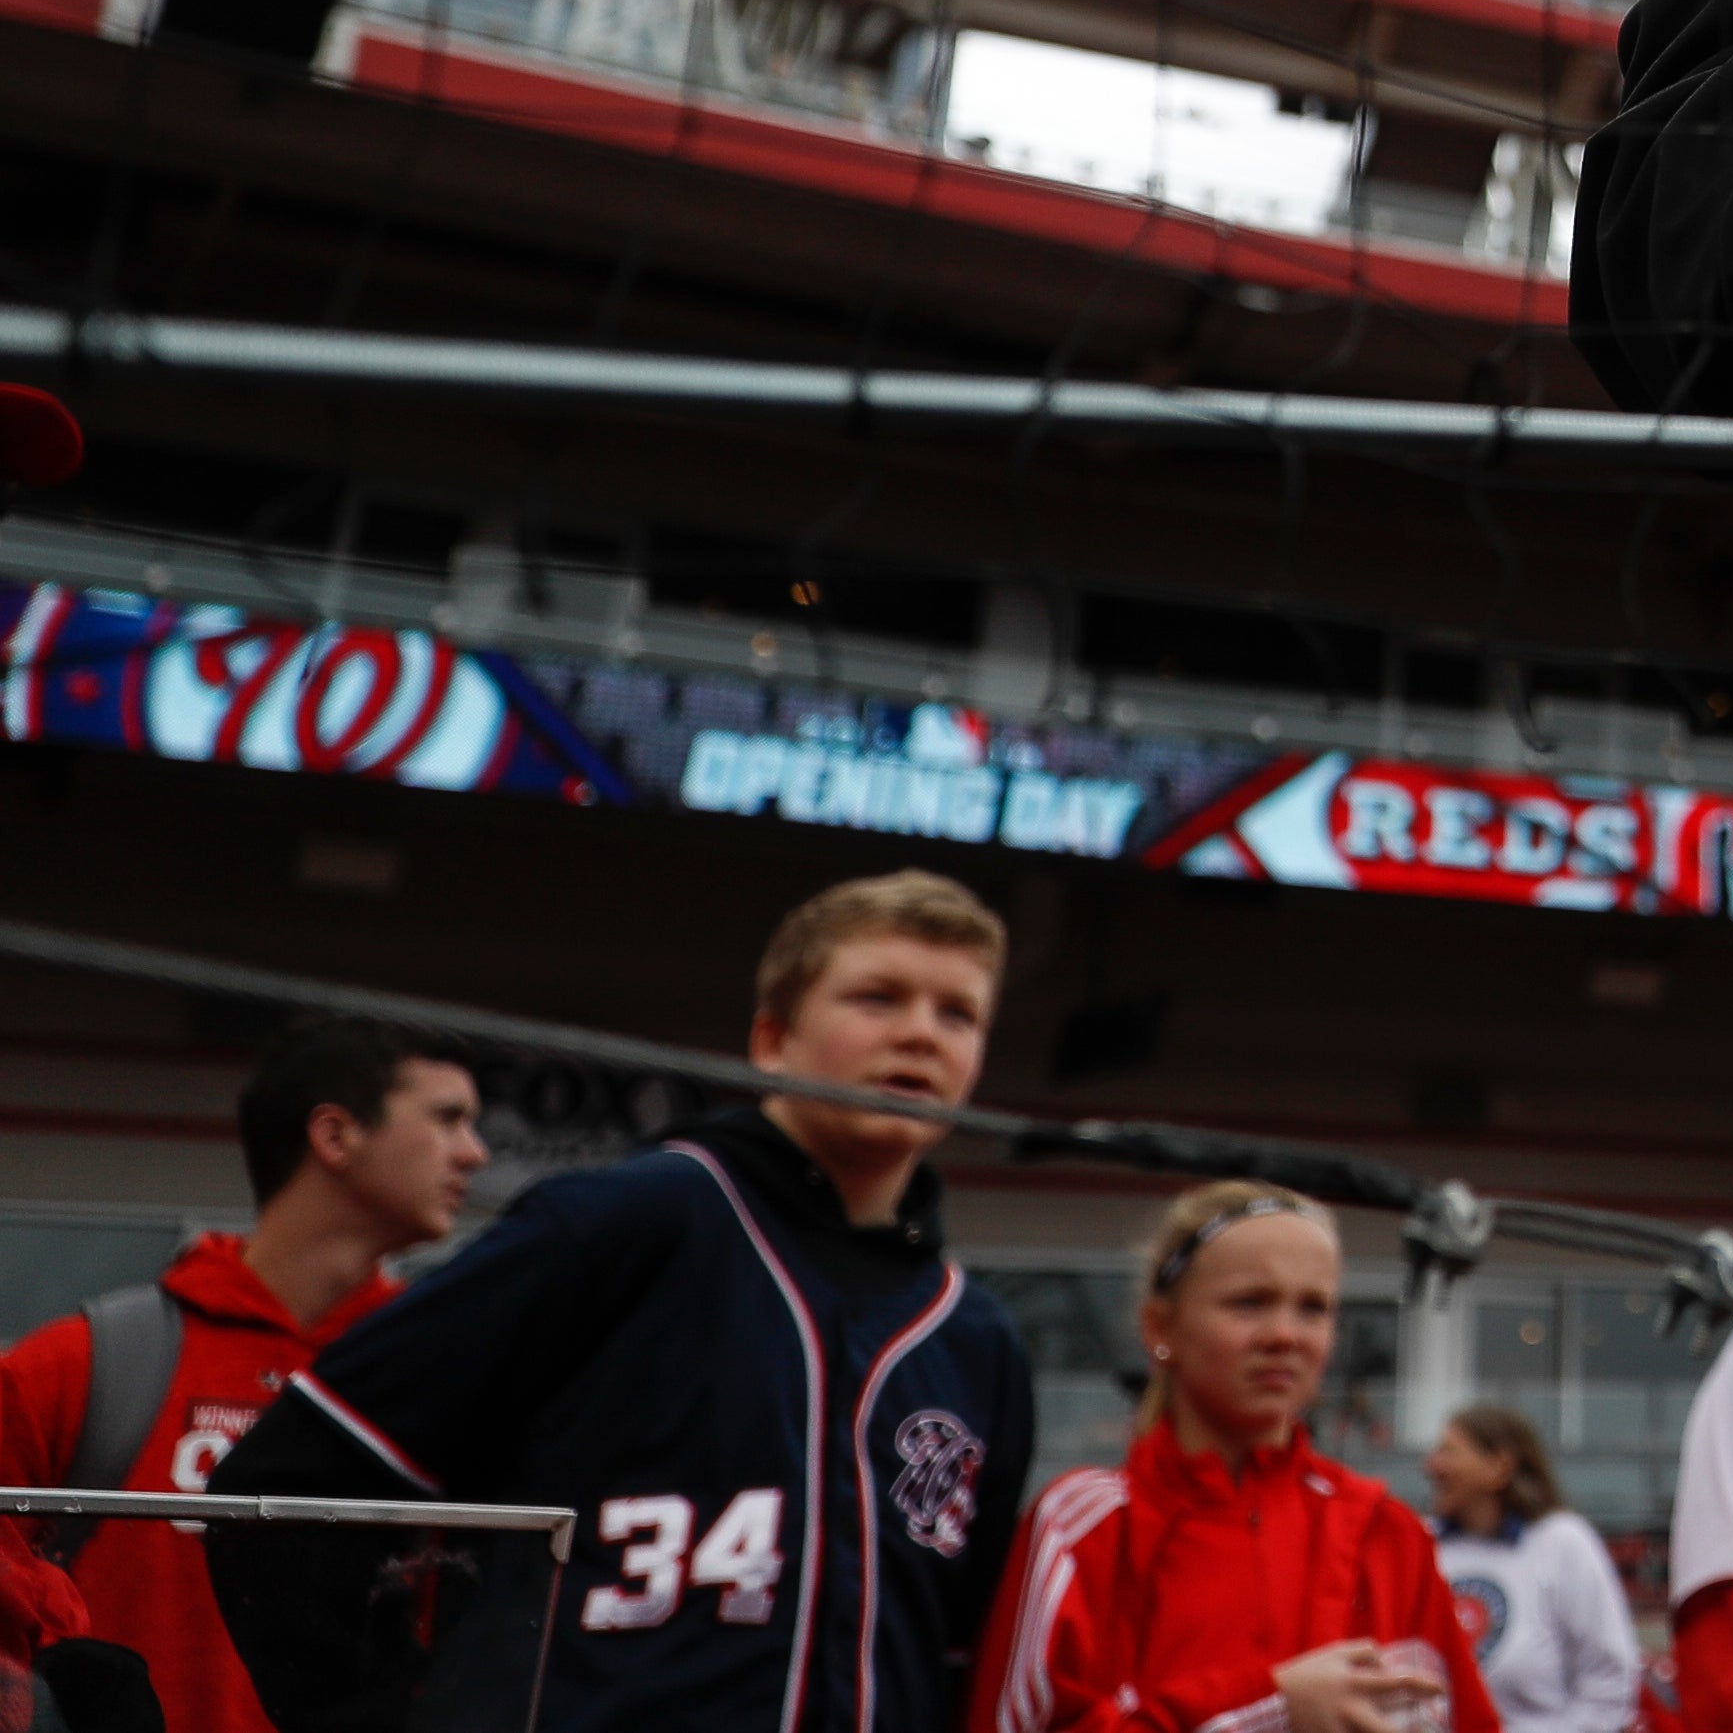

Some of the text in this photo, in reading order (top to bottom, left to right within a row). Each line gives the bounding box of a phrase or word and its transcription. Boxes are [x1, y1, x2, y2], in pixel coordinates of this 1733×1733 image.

[680, 727, 1144, 859] OPENING DAY
[1337, 778, 1642, 878] REDS
[580, 1486, 785, 1632] 34
